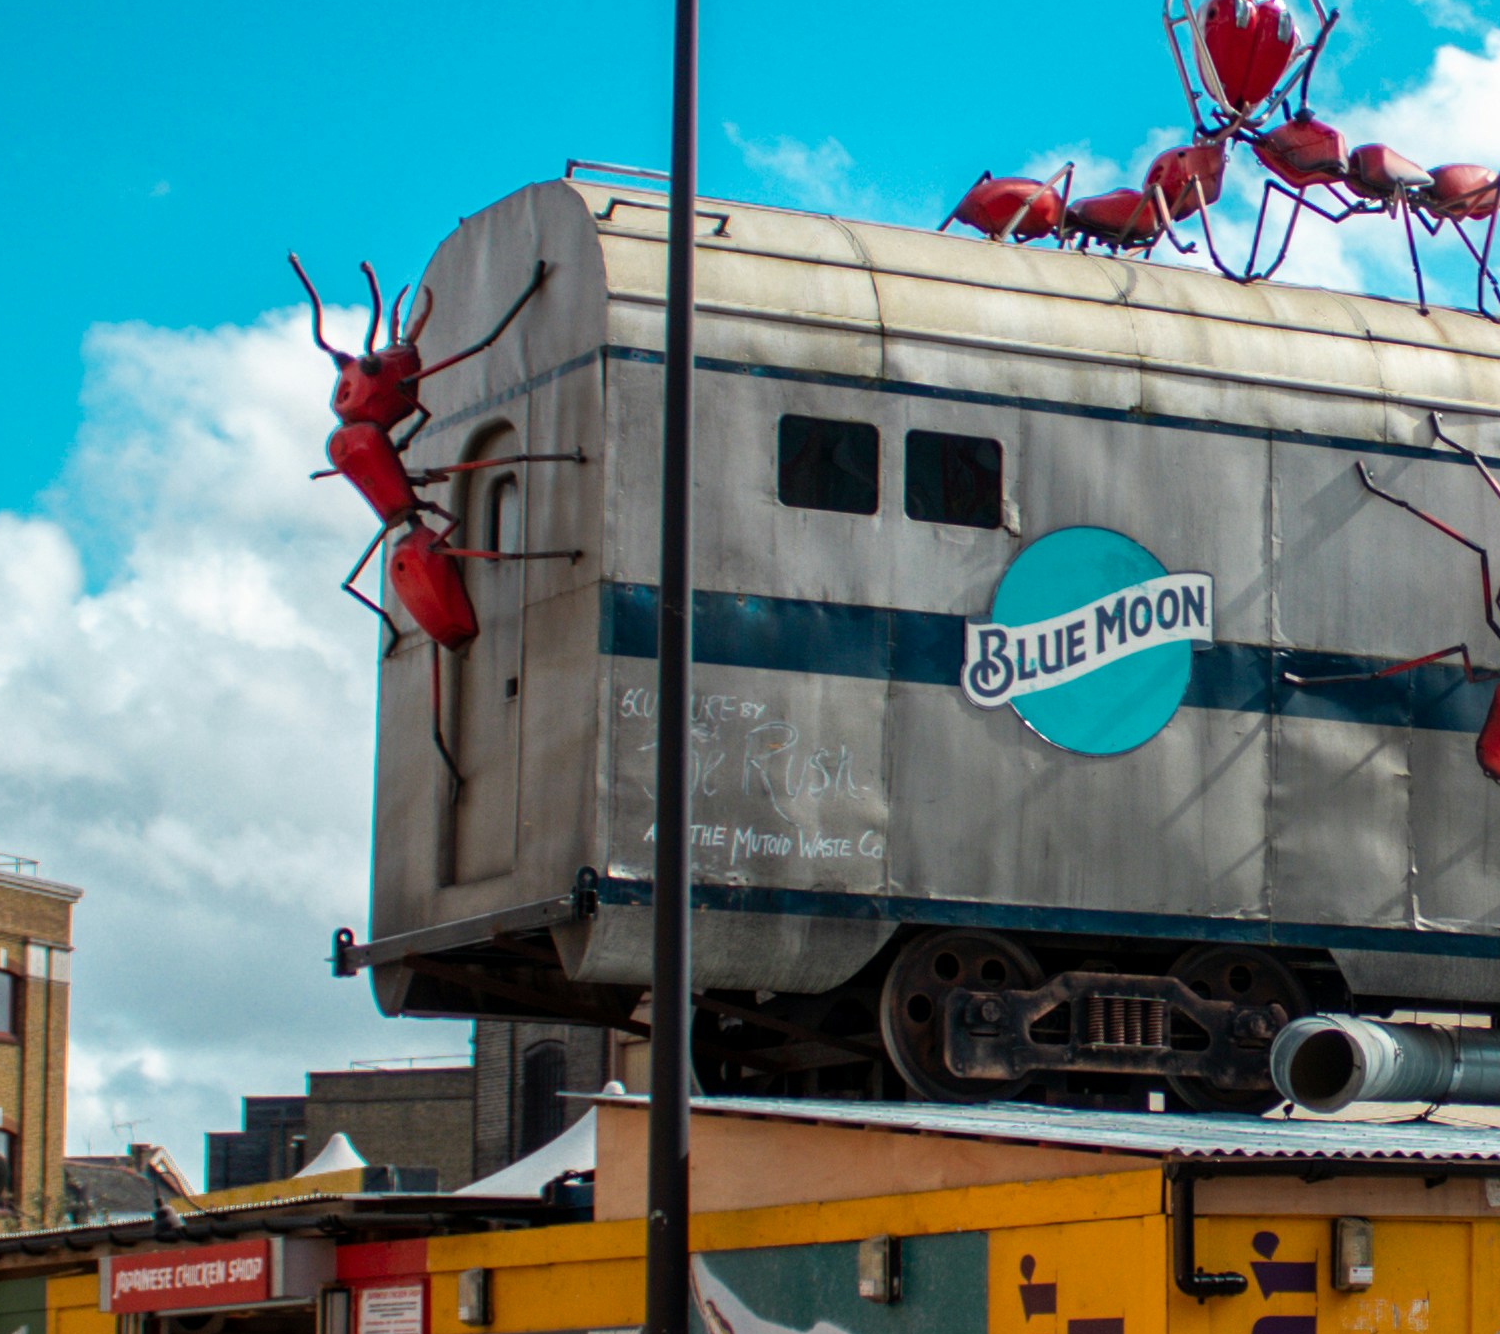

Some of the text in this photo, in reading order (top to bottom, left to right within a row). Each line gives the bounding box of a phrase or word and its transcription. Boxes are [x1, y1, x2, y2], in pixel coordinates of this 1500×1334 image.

[969, 585, 1205, 698] BLUE MOON
[621, 688, 766, 721] SCUURE BY
[689, 824, 727, 847] THE
[799, 830, 851, 858] WASTE
[112, 1256, 263, 1299] JAPANESE CHICKEN SHOP
